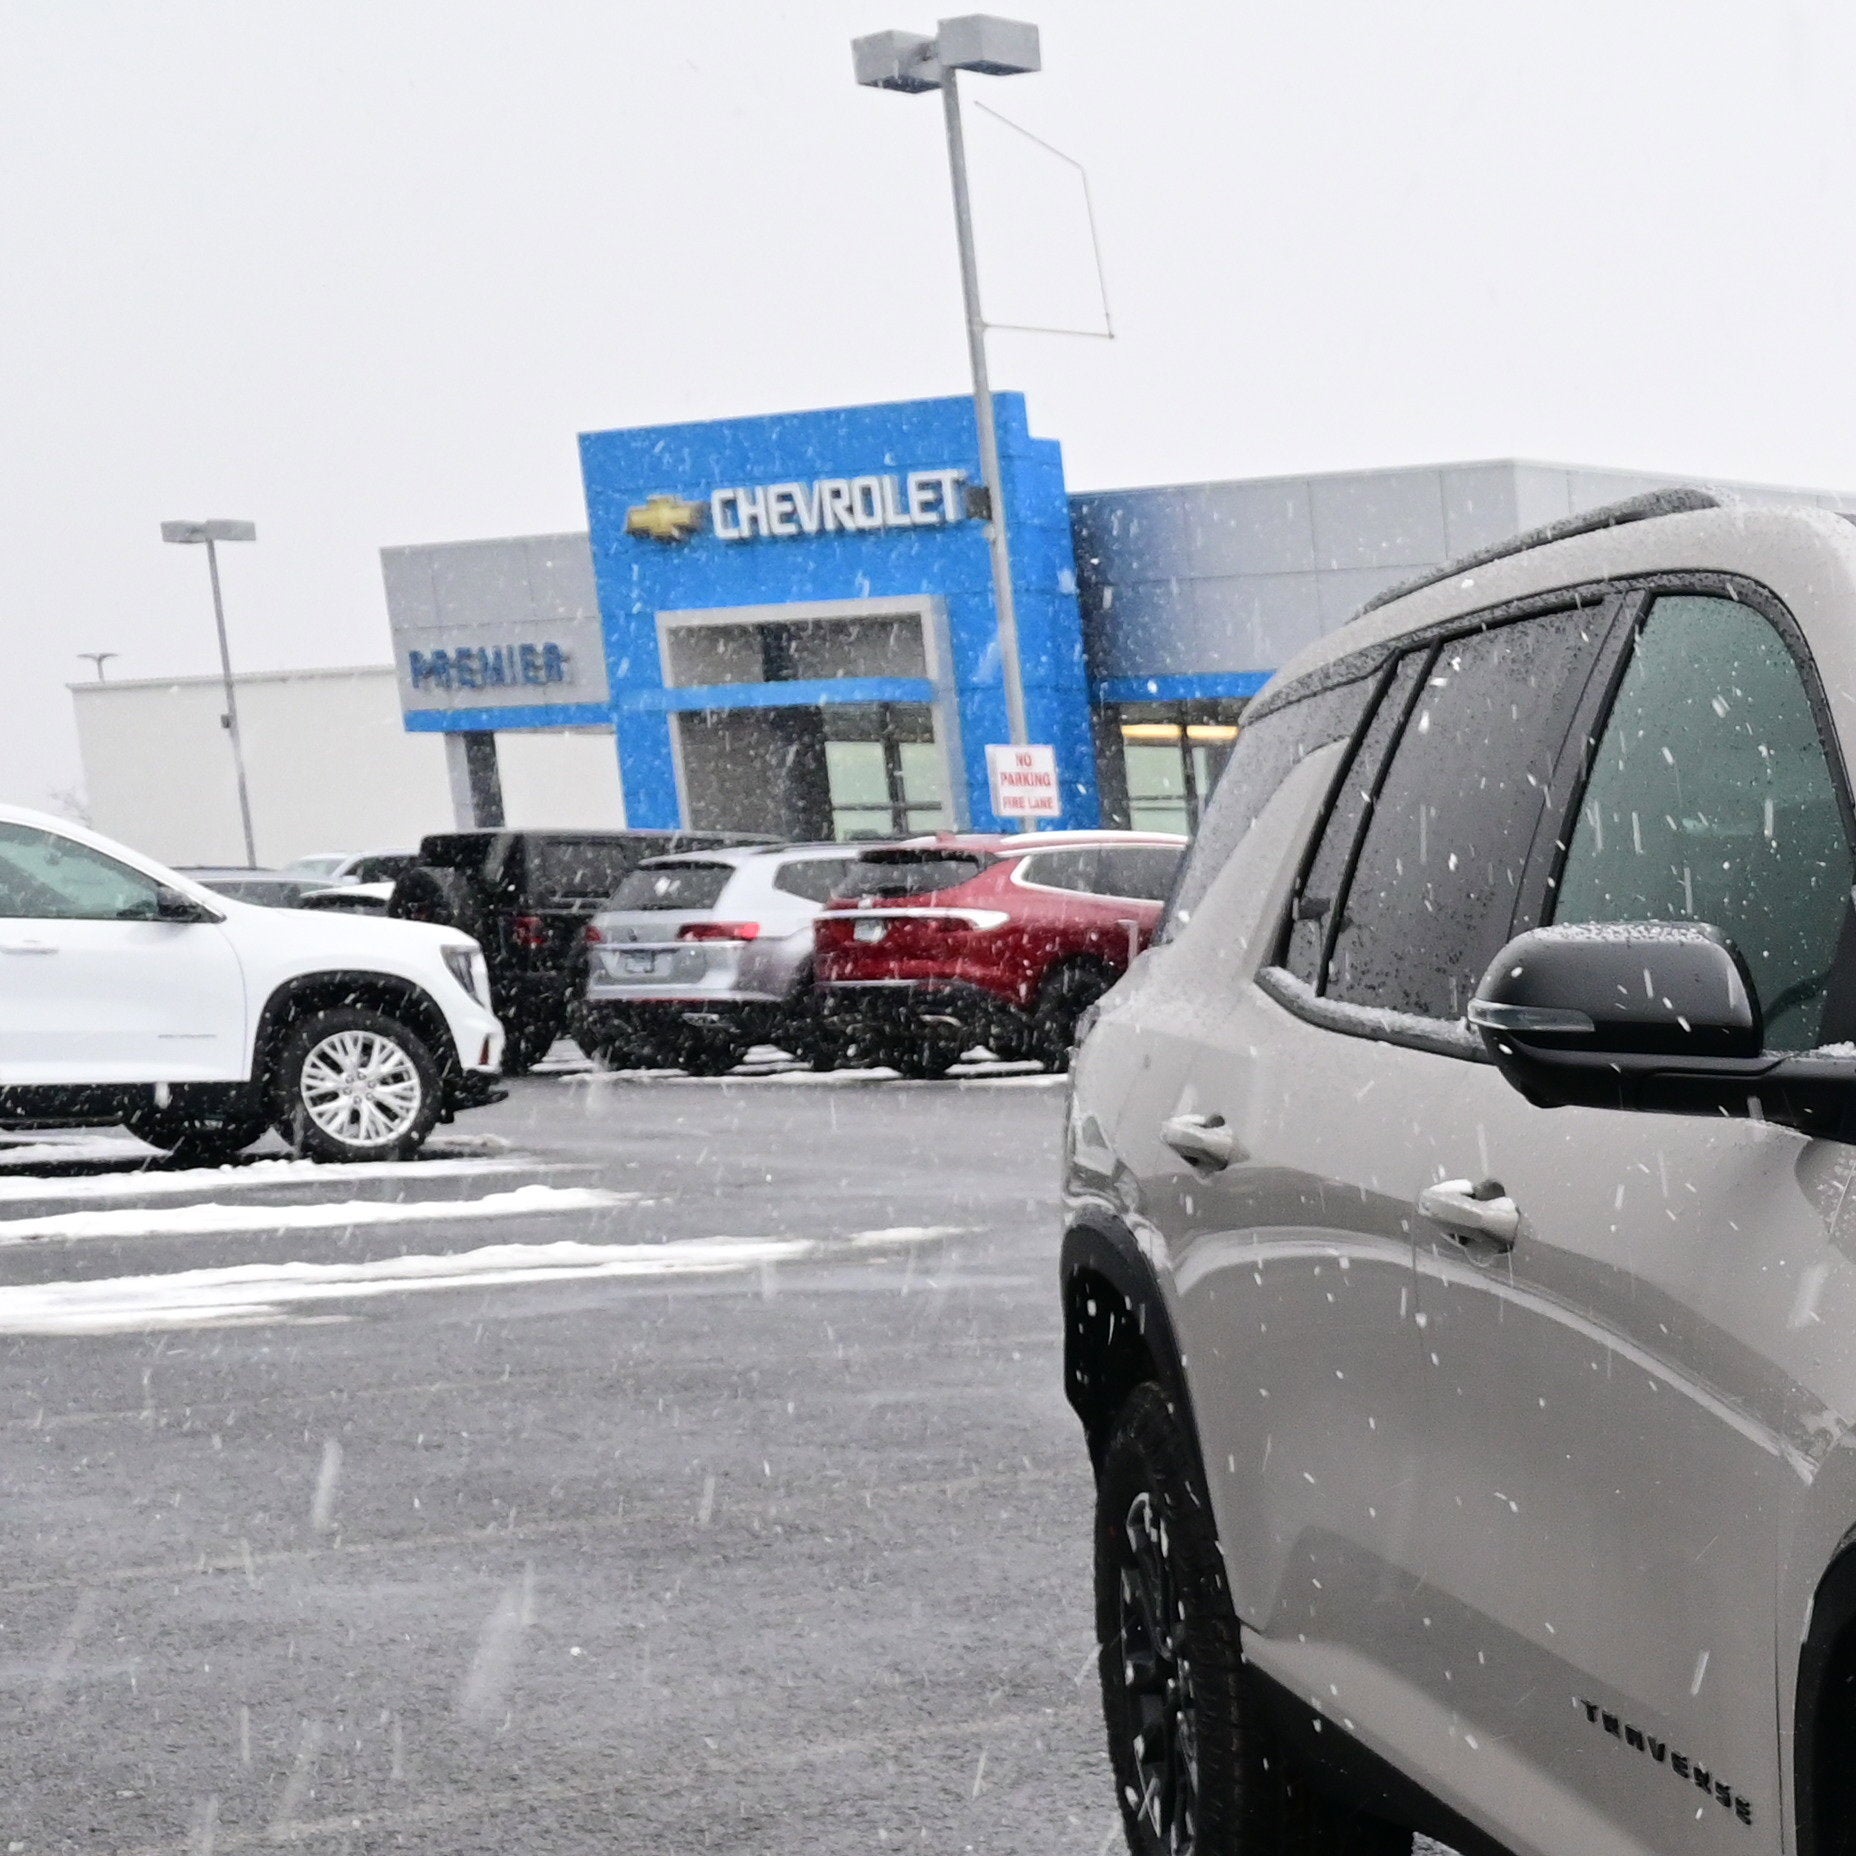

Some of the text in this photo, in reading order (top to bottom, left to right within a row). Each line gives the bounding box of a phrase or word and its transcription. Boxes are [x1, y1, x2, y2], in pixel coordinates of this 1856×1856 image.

[711, 468, 967, 540] CHEVROLET
[409, 642, 566, 690] PREMIER
[1015, 752, 1032, 767] NO
[1000, 772, 1051, 786] PARKING
[1003, 796, 1053, 809] FIRE LANE
[1580, 1699, 1752, 1826] TRAVERSE
